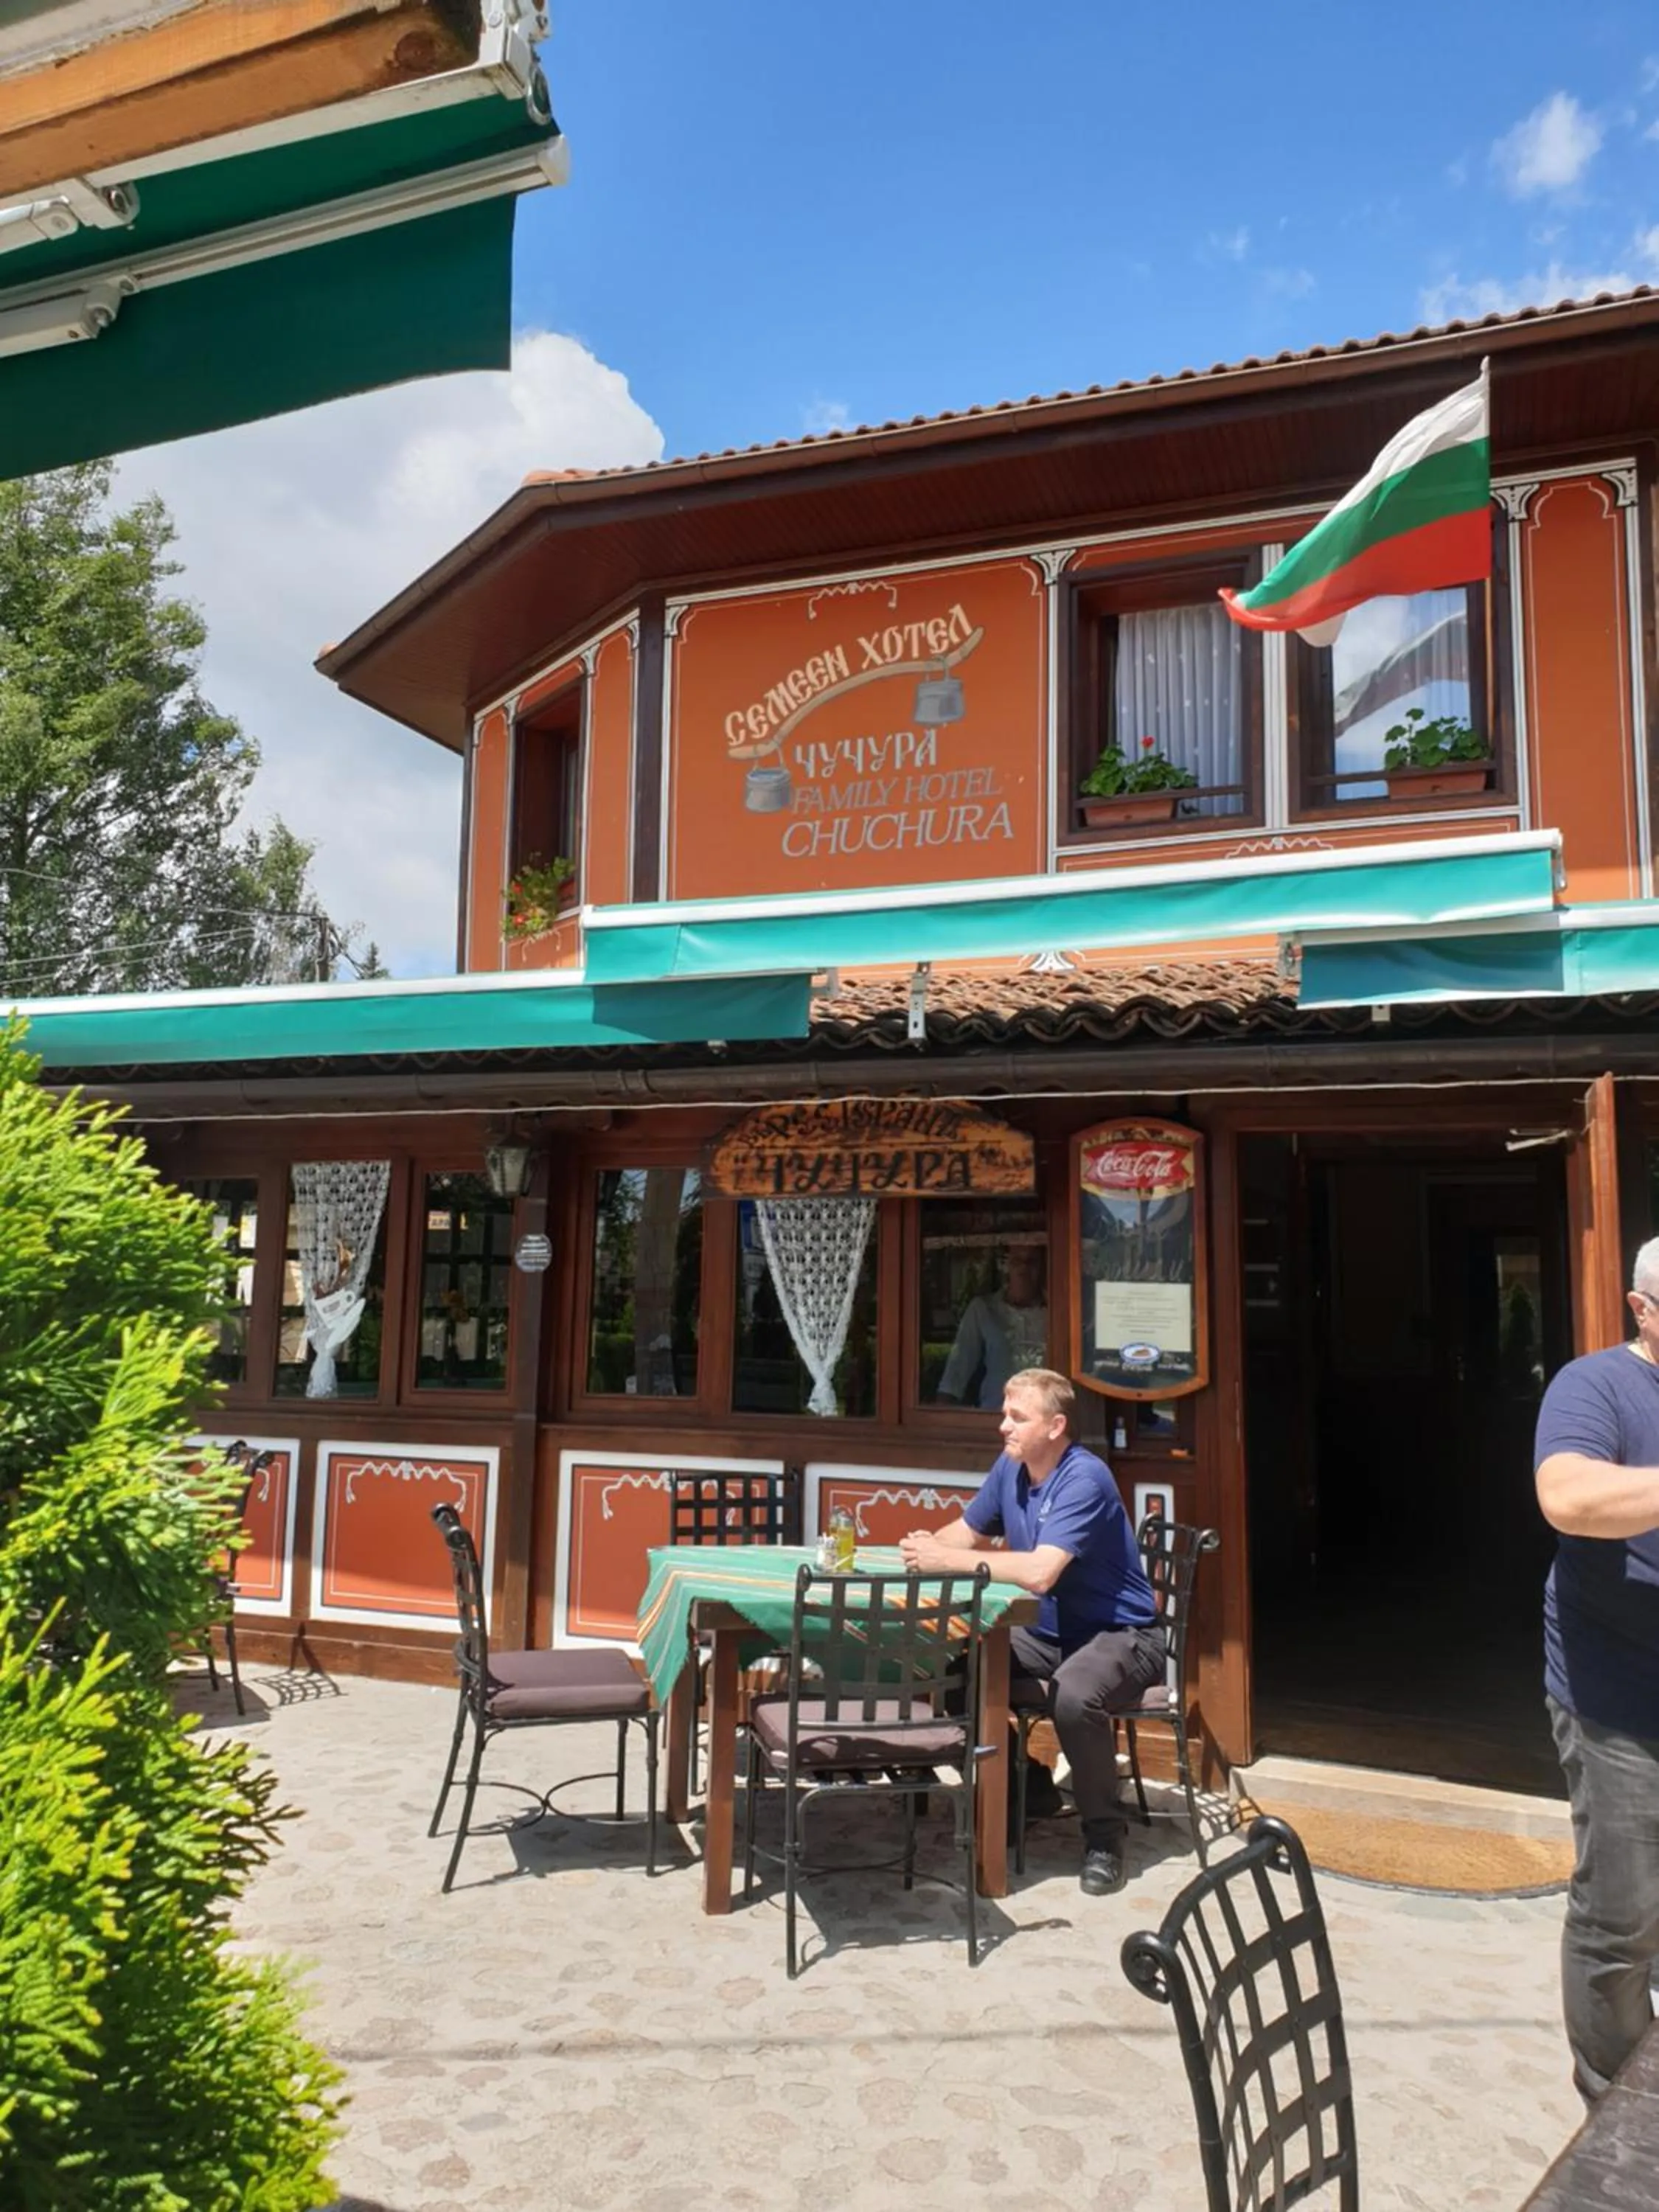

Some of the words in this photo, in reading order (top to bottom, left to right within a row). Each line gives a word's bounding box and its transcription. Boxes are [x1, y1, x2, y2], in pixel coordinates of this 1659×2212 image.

[724, 644, 850, 746] СЕМЕЕН
[857, 603, 973, 670] ХОТЕЛ
[794, 728, 937, 779] ЧУЧУРА
[791, 776, 899, 815] FAMILY
[903, 768, 1004, 804] HOTEL
[782, 801, 1015, 857] CHUCHURA
[1097, 1149, 1175, 1180] Coca-Cola
